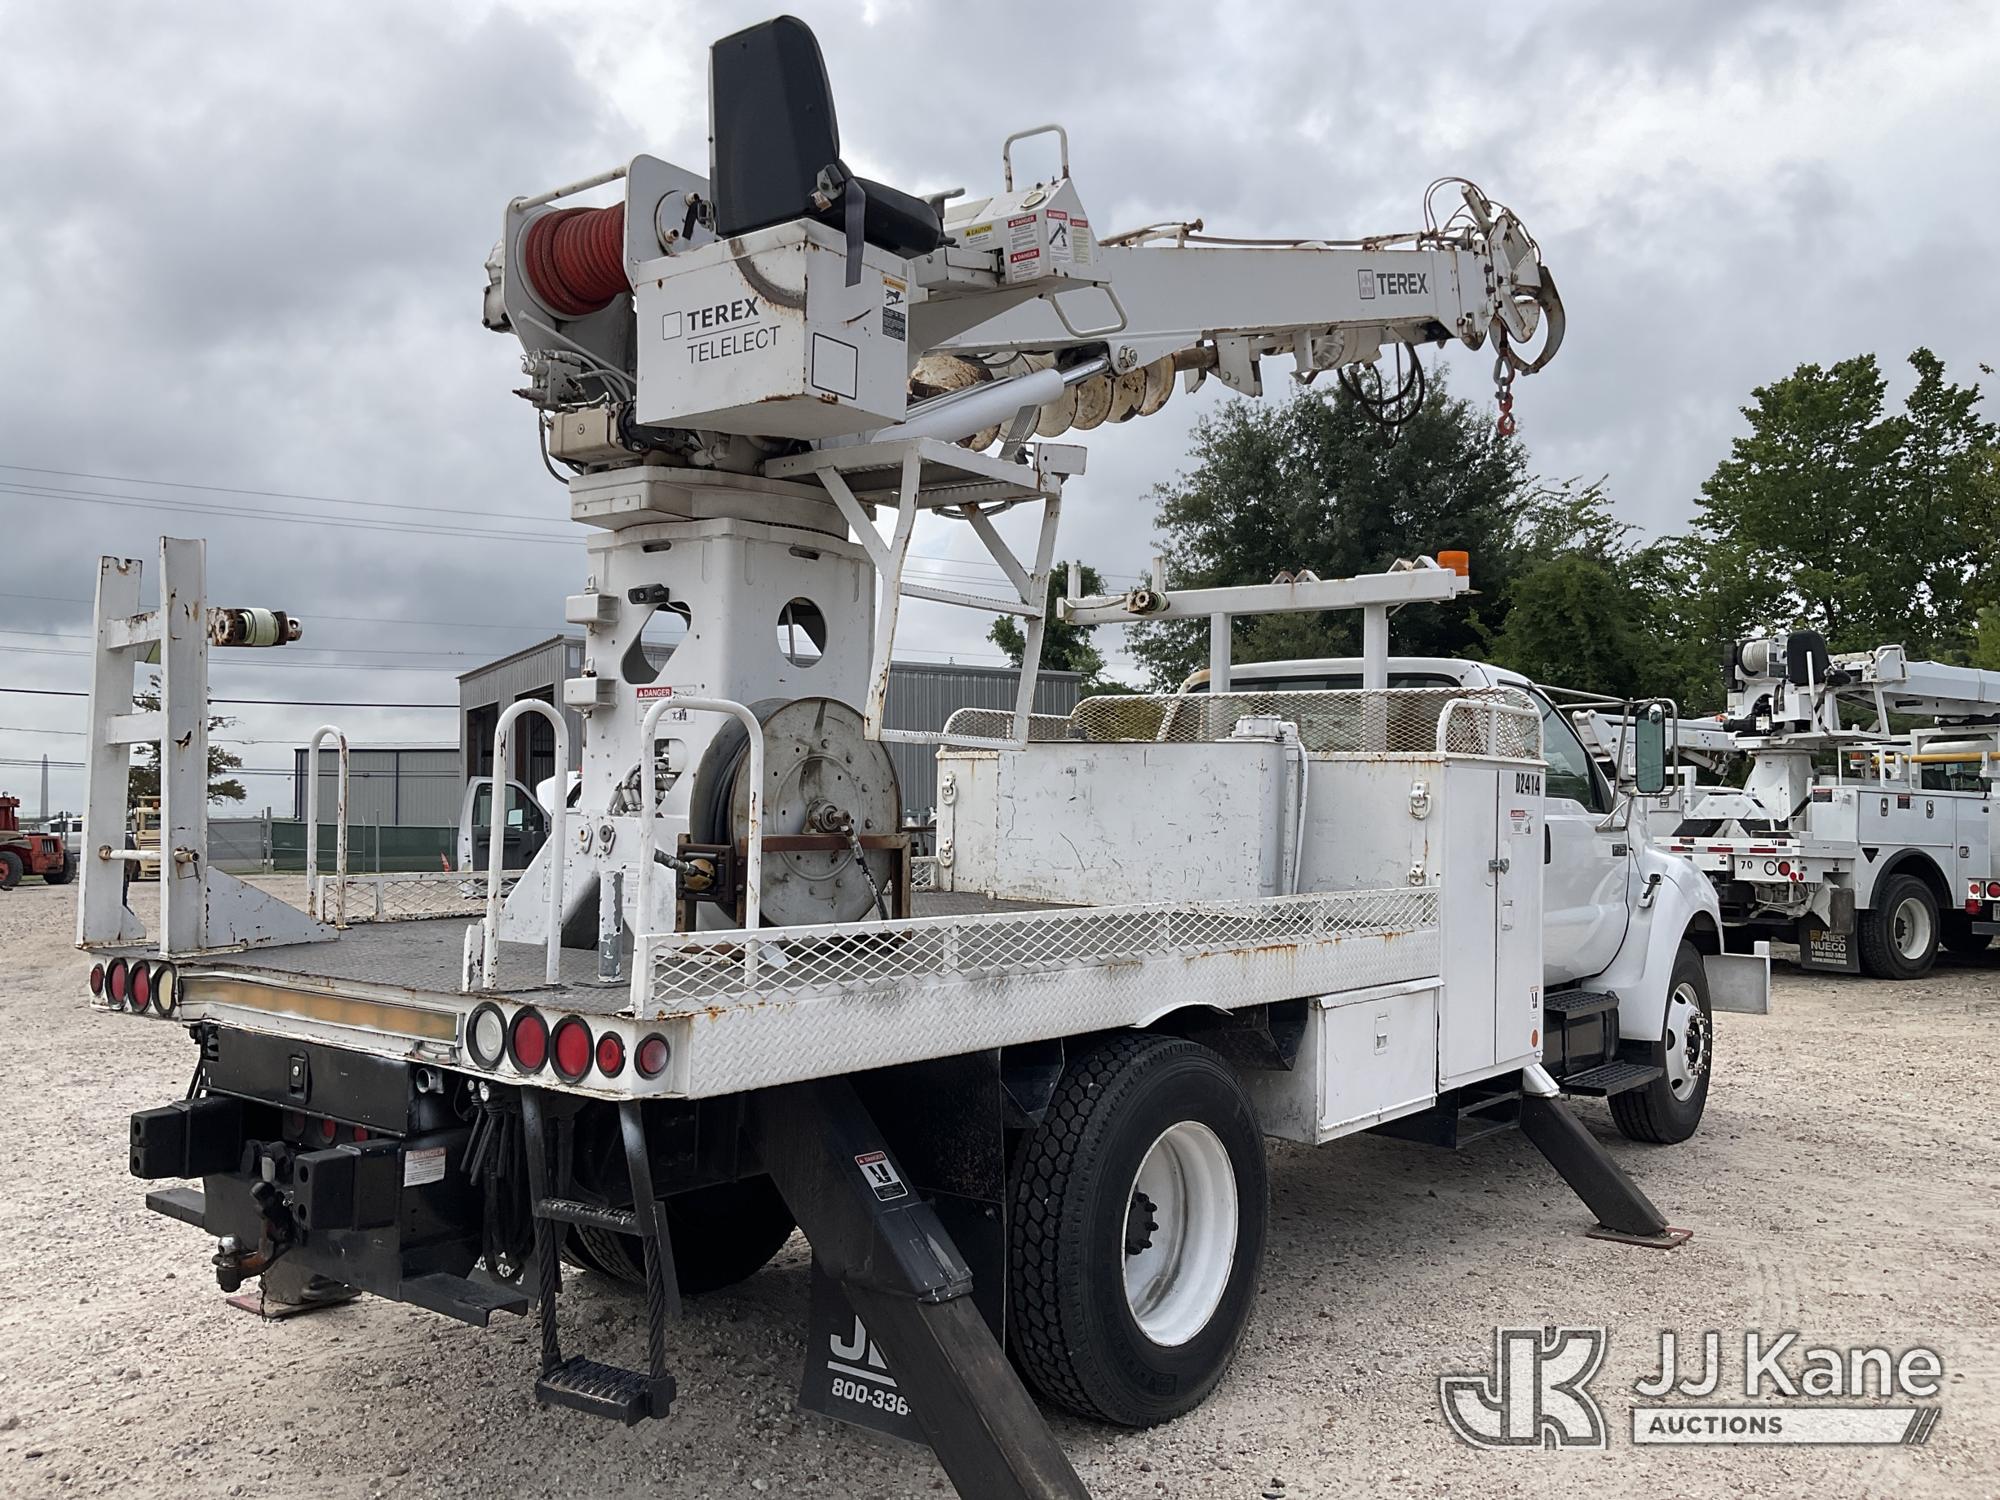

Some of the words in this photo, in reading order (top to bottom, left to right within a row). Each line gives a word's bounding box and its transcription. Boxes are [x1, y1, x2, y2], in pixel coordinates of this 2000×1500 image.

[1015, 215, 1035, 225] DANGER
[1017, 251, 1038, 261] DANGER
[1376, 272, 1428, 295] TEREX
[687, 297, 759, 331] TEREX
[688, 326, 780, 364] TELELECT
[643, 687, 671, 697] DANGER
[1741, 860, 1753, 870] 70
[1810, 941, 1846, 952] NUECO
